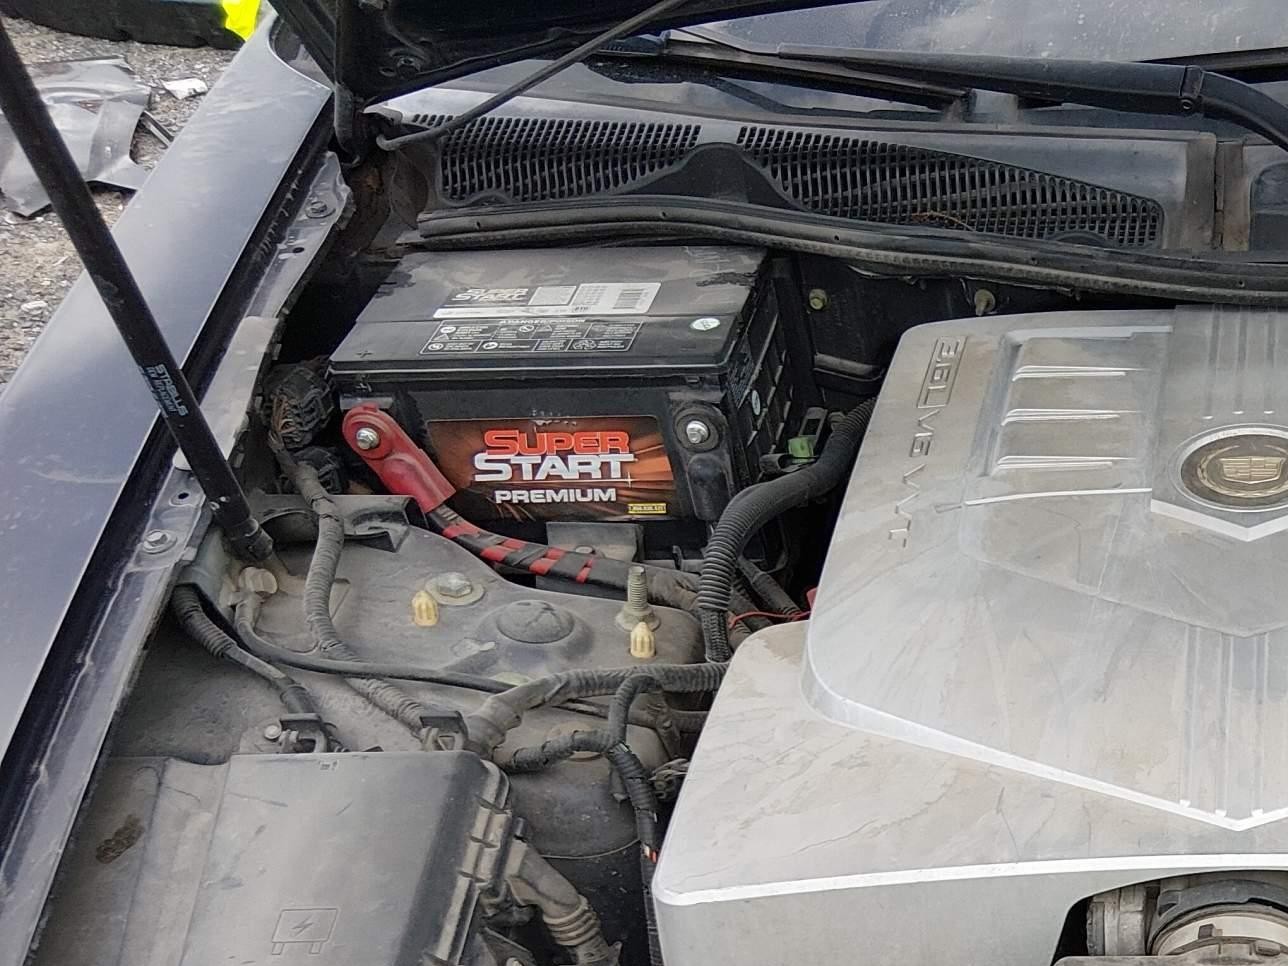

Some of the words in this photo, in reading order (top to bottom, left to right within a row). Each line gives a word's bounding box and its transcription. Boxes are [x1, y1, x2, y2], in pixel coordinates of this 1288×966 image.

[484, 430, 630, 455] SUPER
[910, 410, 940, 457] V6
[473, 452, 635, 482] START
[495, 488, 617, 504] PREMIUM
